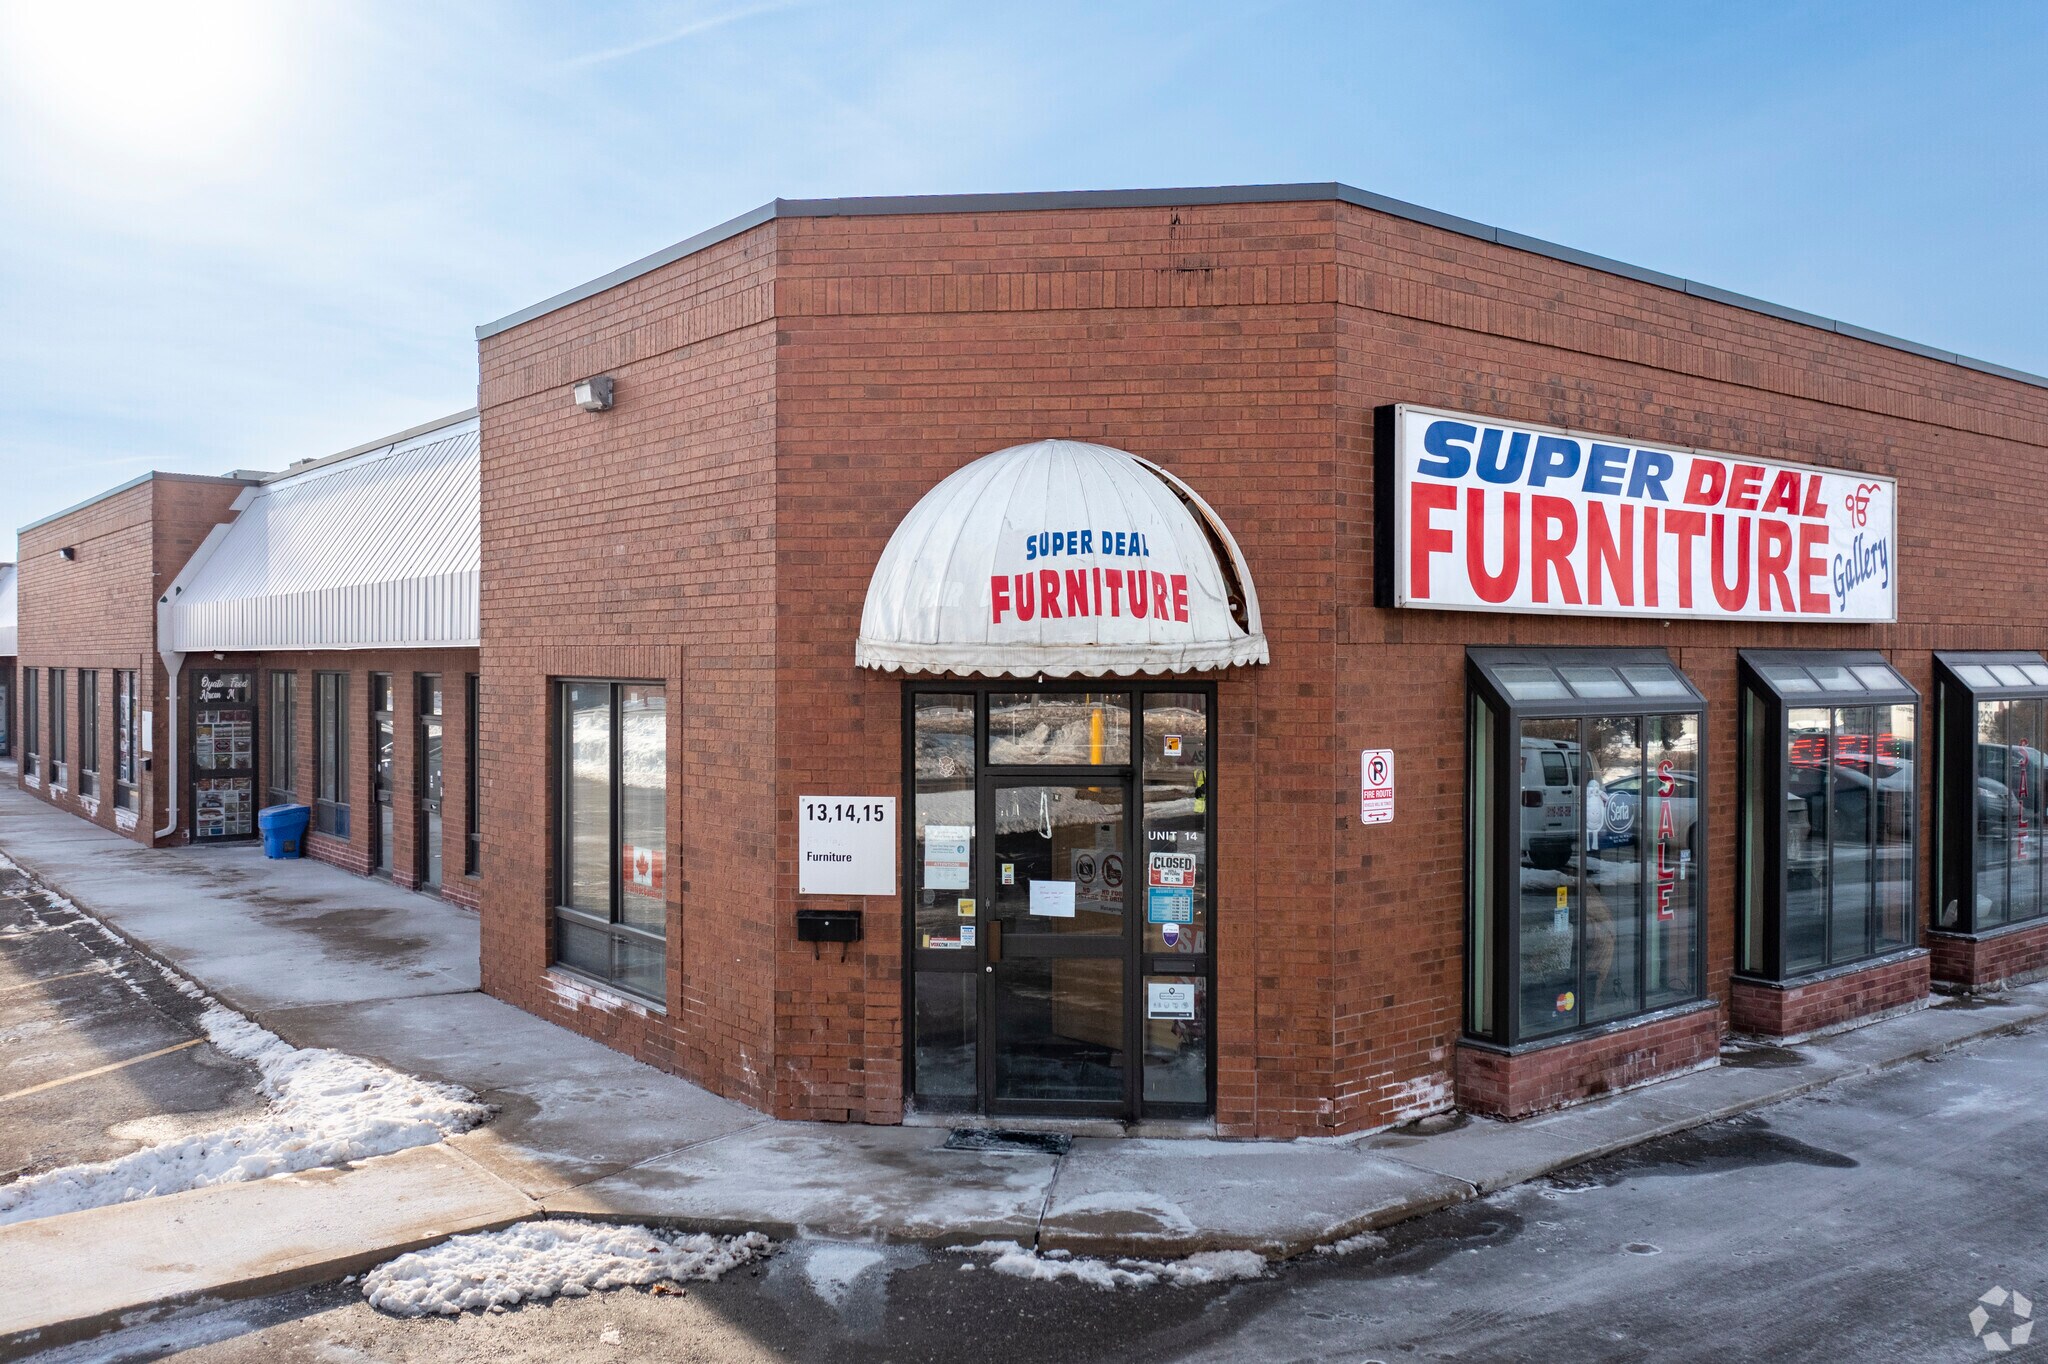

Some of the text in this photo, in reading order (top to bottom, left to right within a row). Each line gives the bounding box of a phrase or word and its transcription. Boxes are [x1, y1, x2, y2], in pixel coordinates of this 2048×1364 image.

[1417, 420, 1829, 519] SUPER DEAL
[1026, 529, 1150, 560] SUPER DEAL
[1411, 481, 1831, 615] FURNITURE
[1833, 532, 1888, 612] Gallery
[990, 567, 1189, 624] FURNITURE
[1364, 789, 1392, 799] FIRE ROUTE
[2018, 738, 2029, 860] SALE
[806, 803, 884, 823] 13,14,15
[1611, 802, 1629, 821] Serta
[1148, 831, 1198, 841] UNIT 14
[1656, 759, 1675, 922] SALE
[806, 851, 852, 862] Furniture
[1153, 856, 1192, 871] CLOSED
